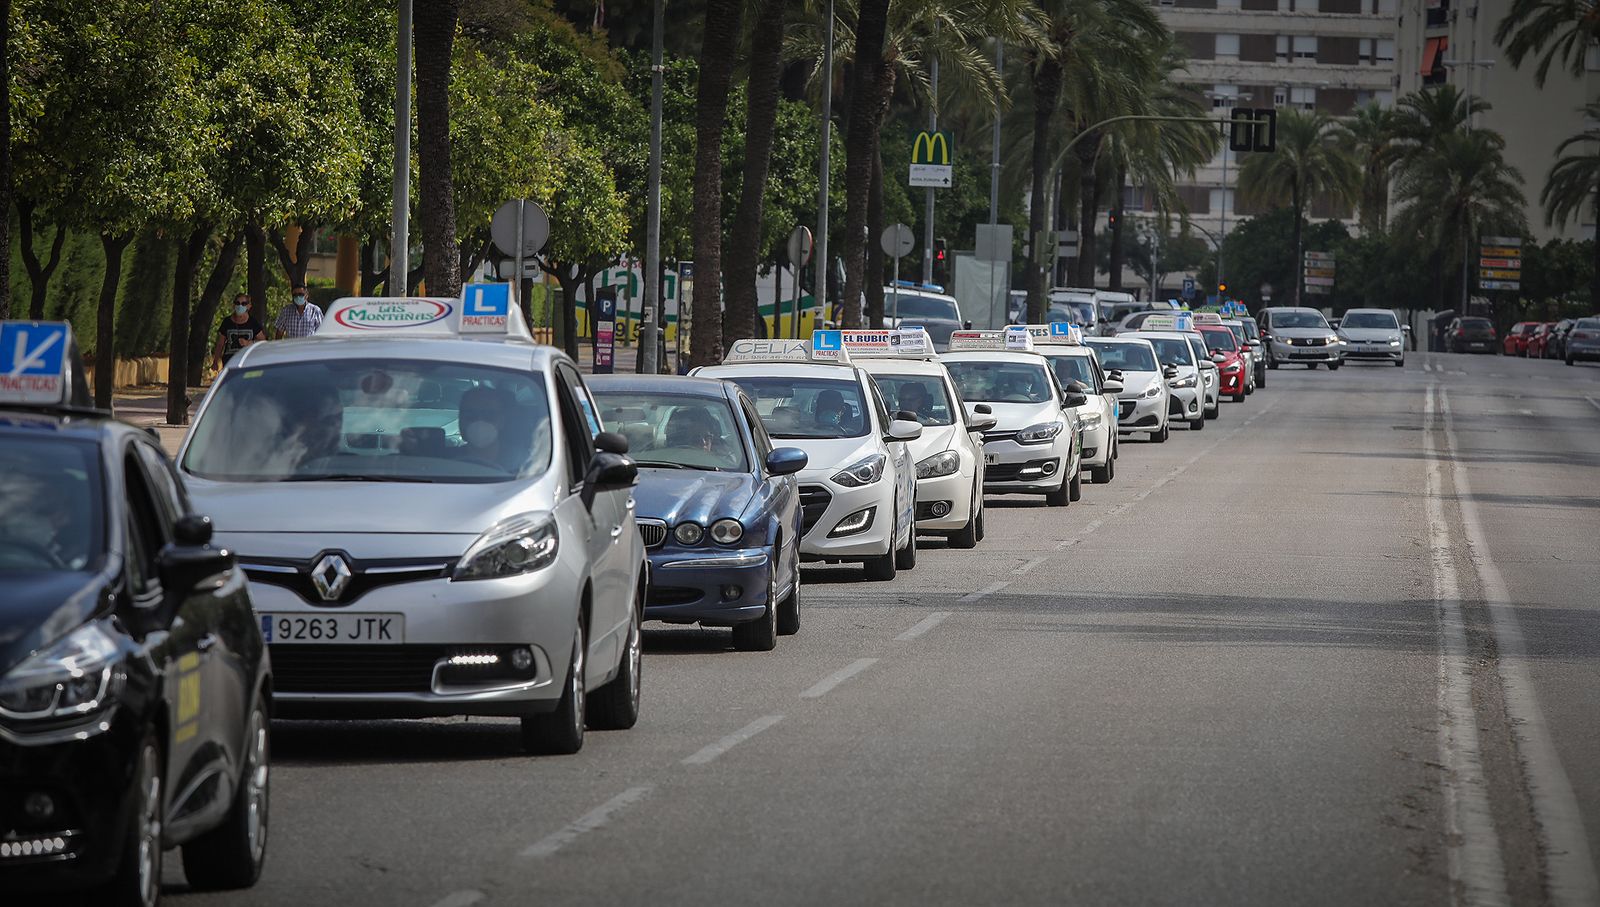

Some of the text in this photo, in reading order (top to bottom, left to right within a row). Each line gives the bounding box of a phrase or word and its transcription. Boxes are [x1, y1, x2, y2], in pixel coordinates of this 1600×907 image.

[475, 290, 496, 312] L
[602, 300, 611, 313] P
[463, 316, 506, 326] PRACTICAS
[1055, 324, 1065, 334] L
[821, 334, 834, 348] L
[735, 343, 809, 354] CELIA
[279, 618, 392, 640] 9263 JTK
